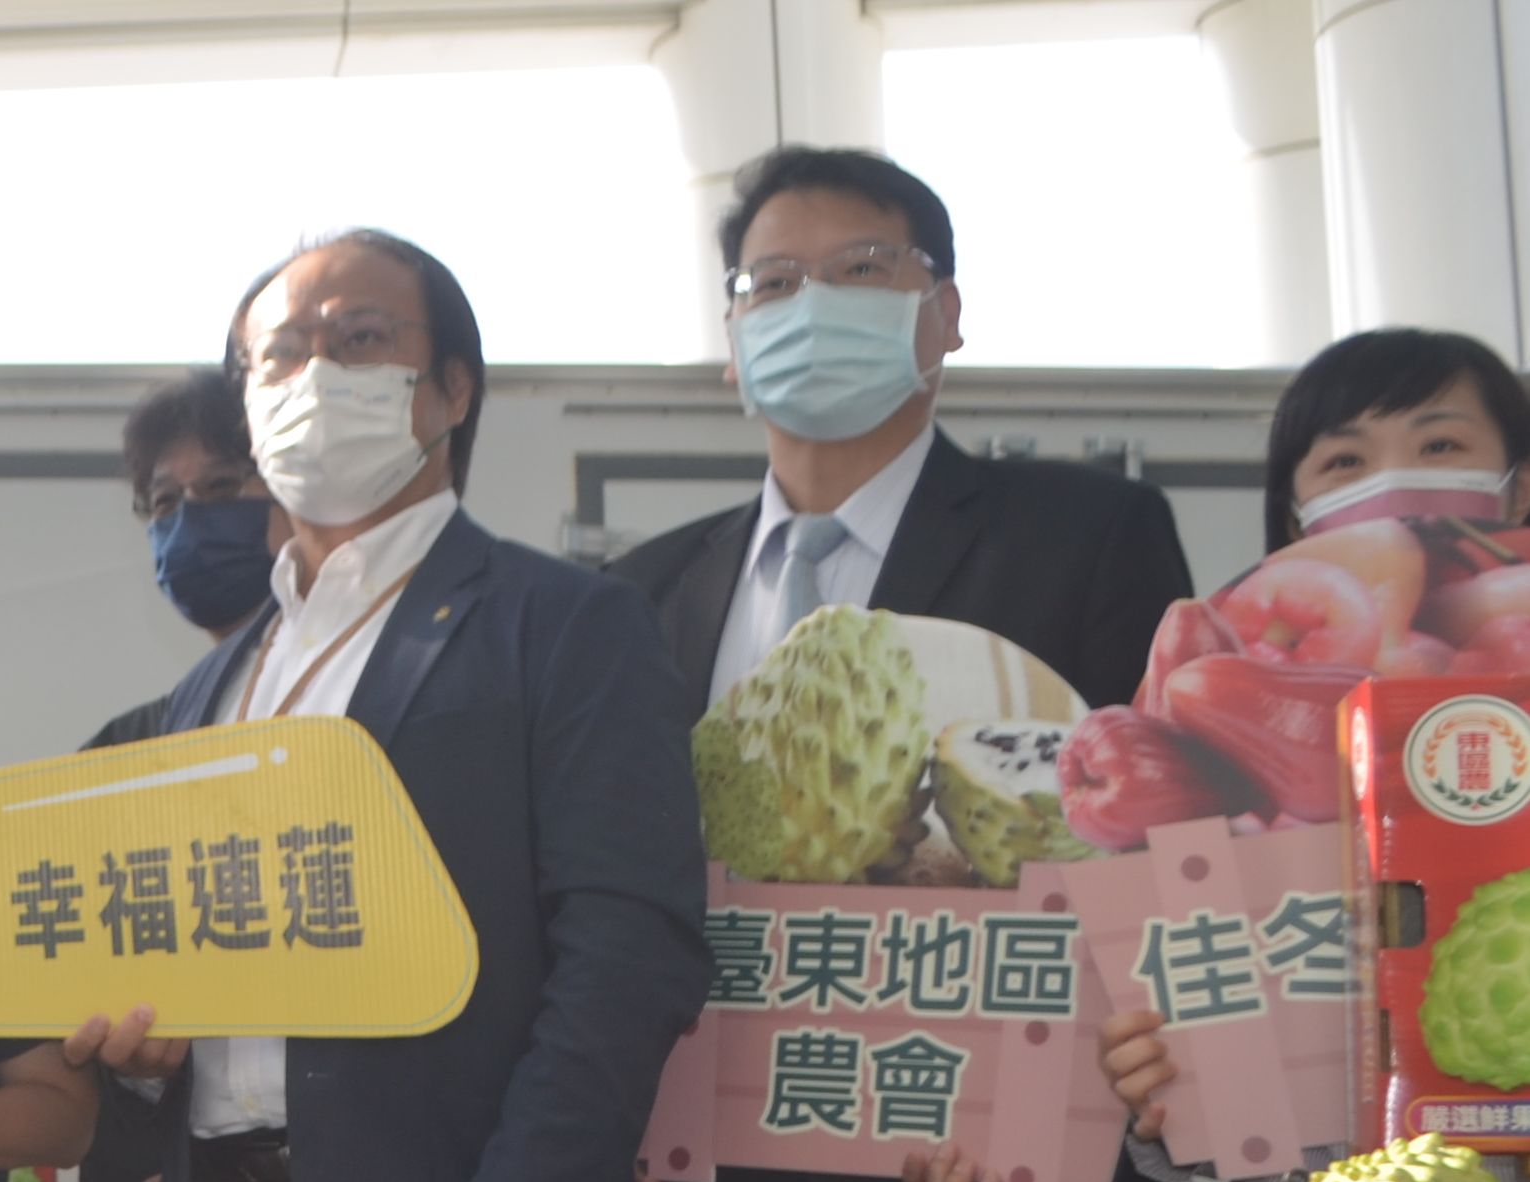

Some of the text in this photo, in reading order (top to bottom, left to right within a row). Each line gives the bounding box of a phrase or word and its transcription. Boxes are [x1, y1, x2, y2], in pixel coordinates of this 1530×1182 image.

[705, 906, 1079, 1020] 臺東地區
[761, 1026, 970, 1141] 農會
